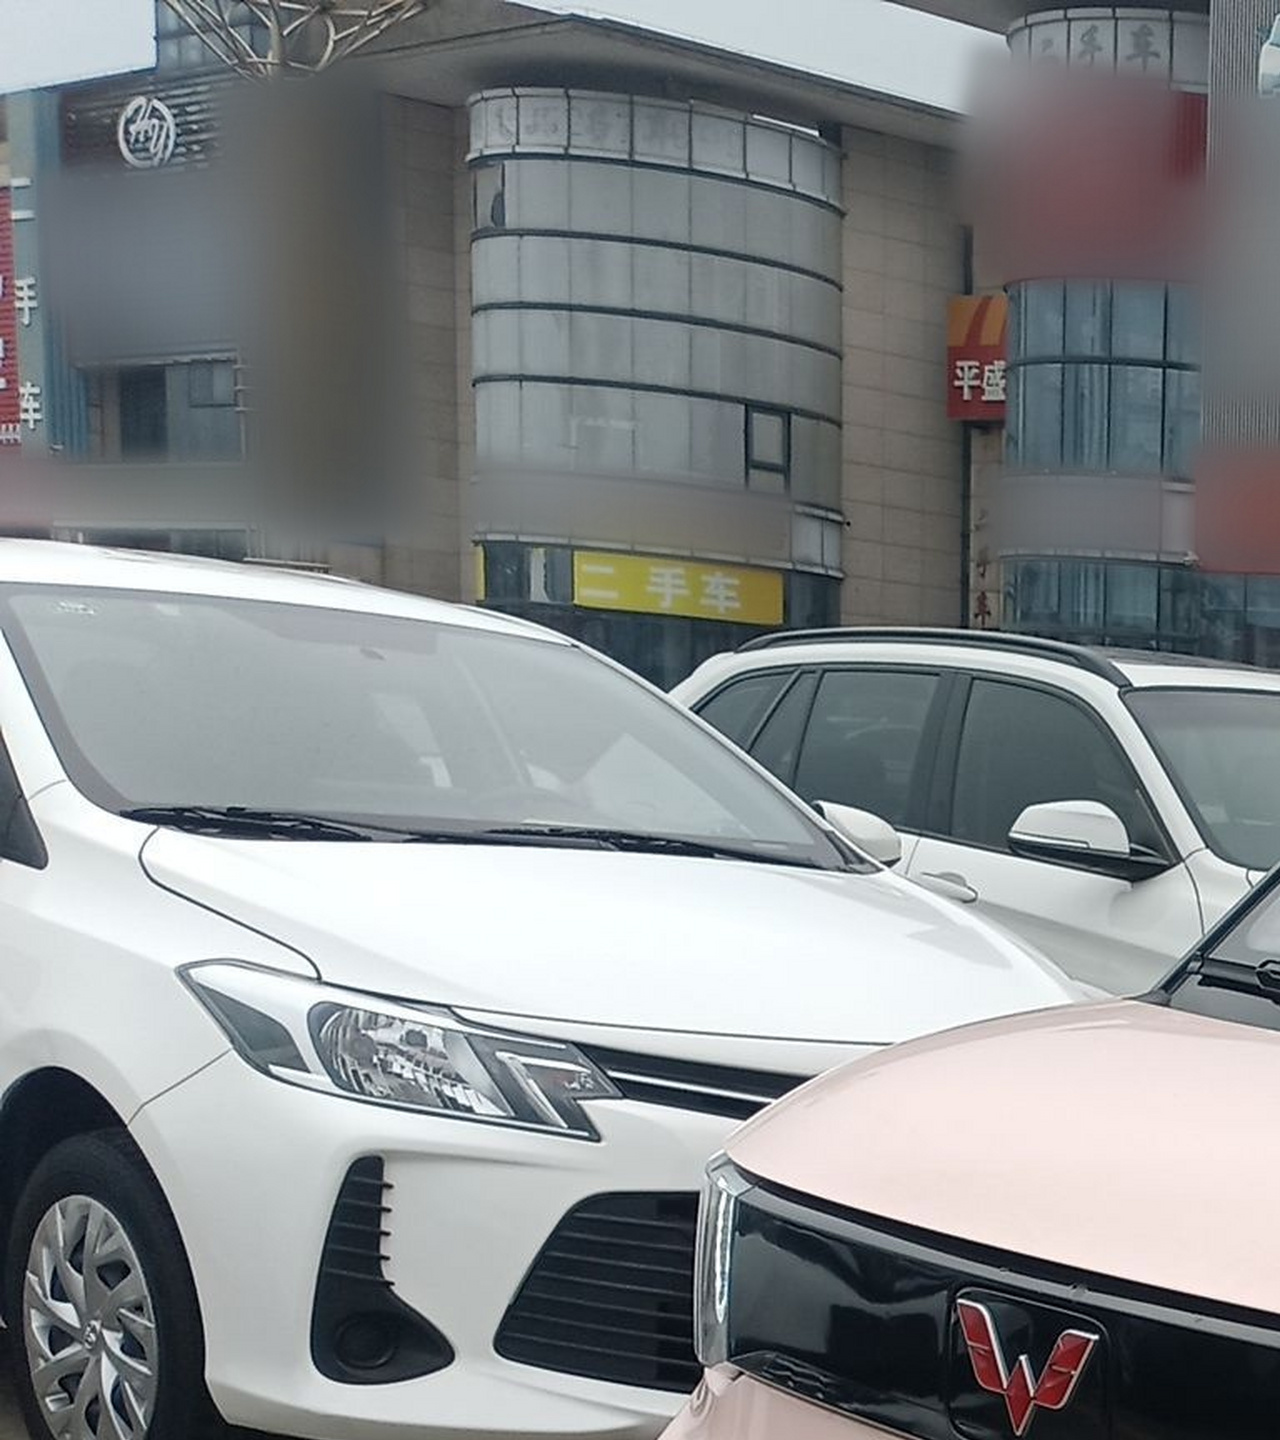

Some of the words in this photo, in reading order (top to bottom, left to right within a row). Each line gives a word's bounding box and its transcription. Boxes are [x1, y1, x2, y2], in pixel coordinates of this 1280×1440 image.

[10, 177, 42, 430] 二手车
[580, 563, 742, 614] 二手车
